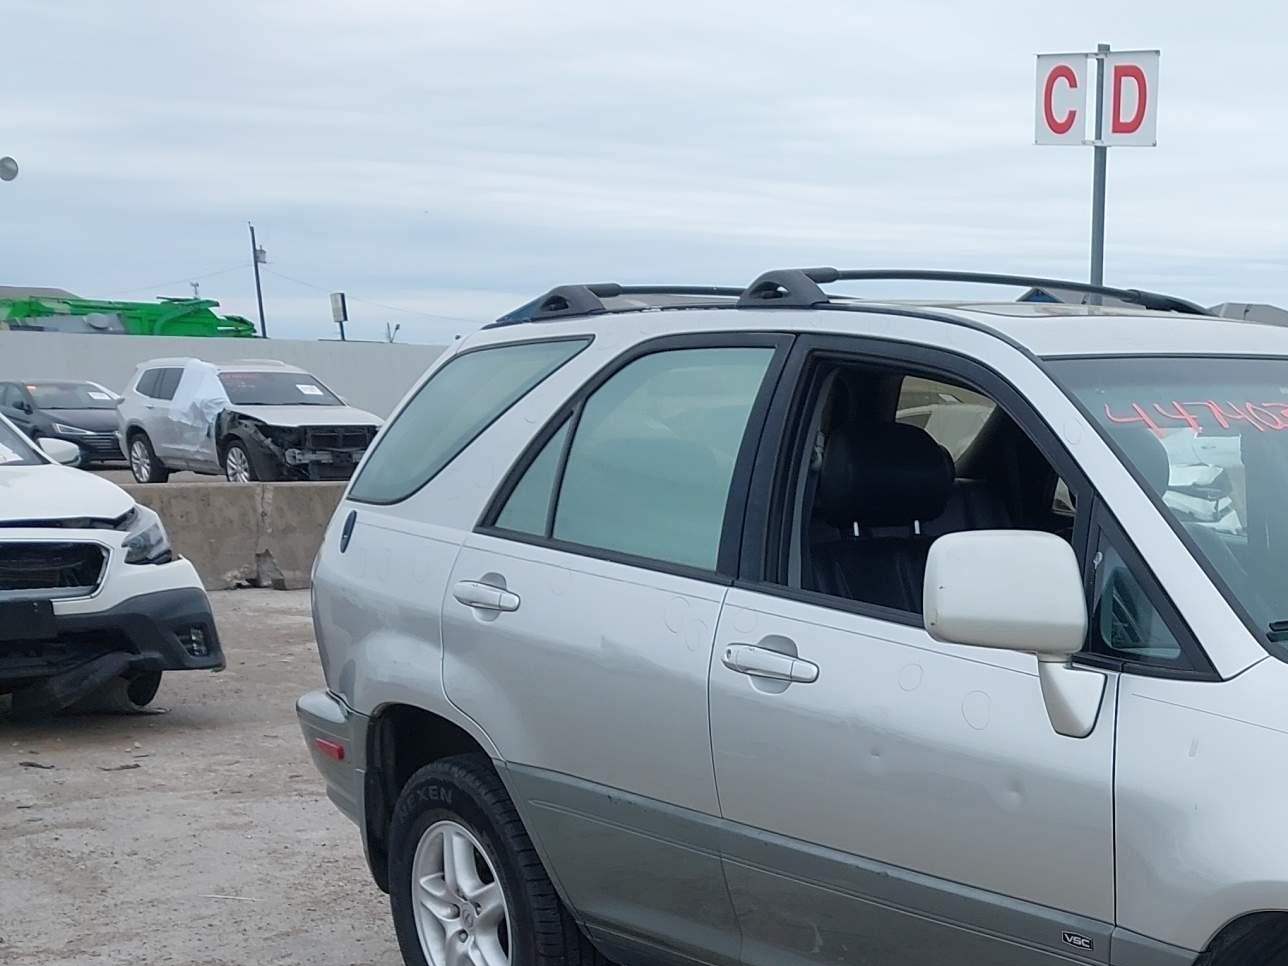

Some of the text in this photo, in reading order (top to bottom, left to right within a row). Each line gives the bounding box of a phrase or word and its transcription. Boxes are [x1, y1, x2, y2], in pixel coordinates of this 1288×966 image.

[1043, 64, 1078, 135] C
[1111, 64, 1148, 134] D
[1063, 933, 1091, 948] VSC
